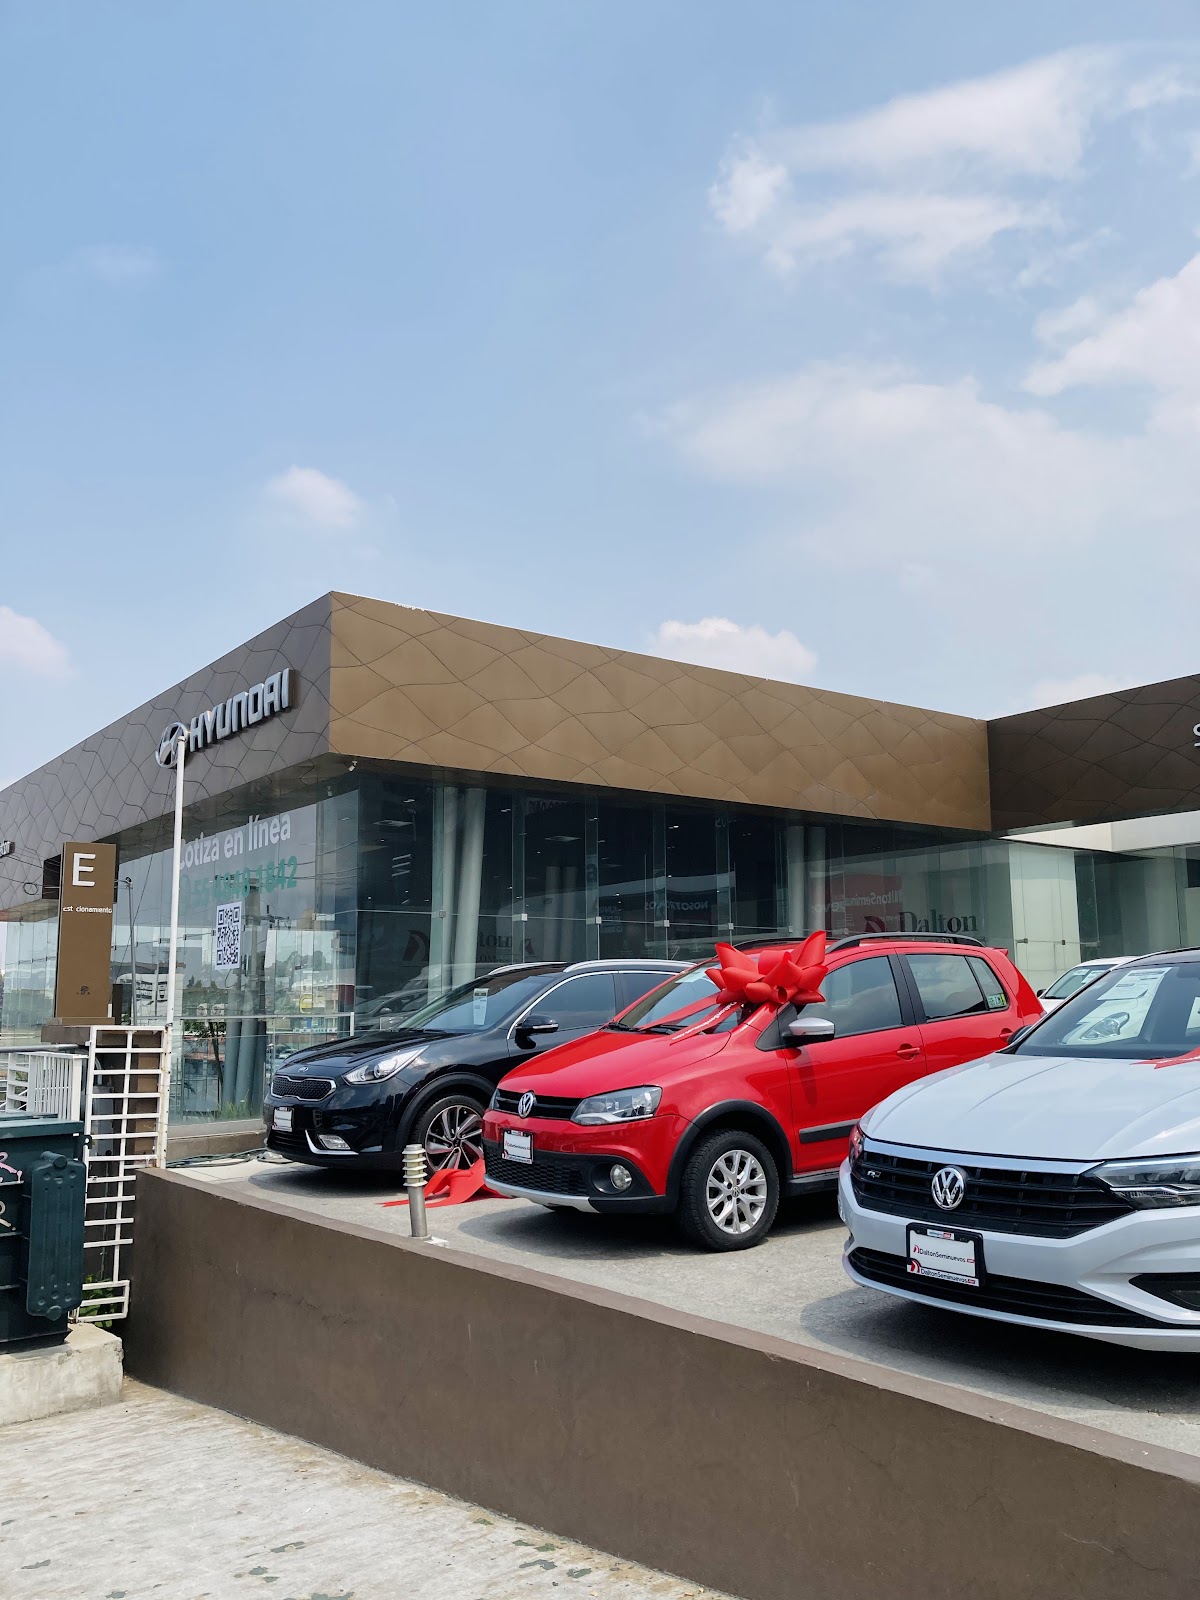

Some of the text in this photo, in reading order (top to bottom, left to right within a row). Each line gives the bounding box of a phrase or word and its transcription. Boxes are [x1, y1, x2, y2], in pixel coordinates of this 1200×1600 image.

[189, 667, 290, 753] HYUNDAI
[223, 830, 244, 859] en
[248, 814, 291, 852] línea
[72, 852, 97, 887] E
[256, 855, 298, 895] 1842
[898, 909, 979, 933] Dalton
